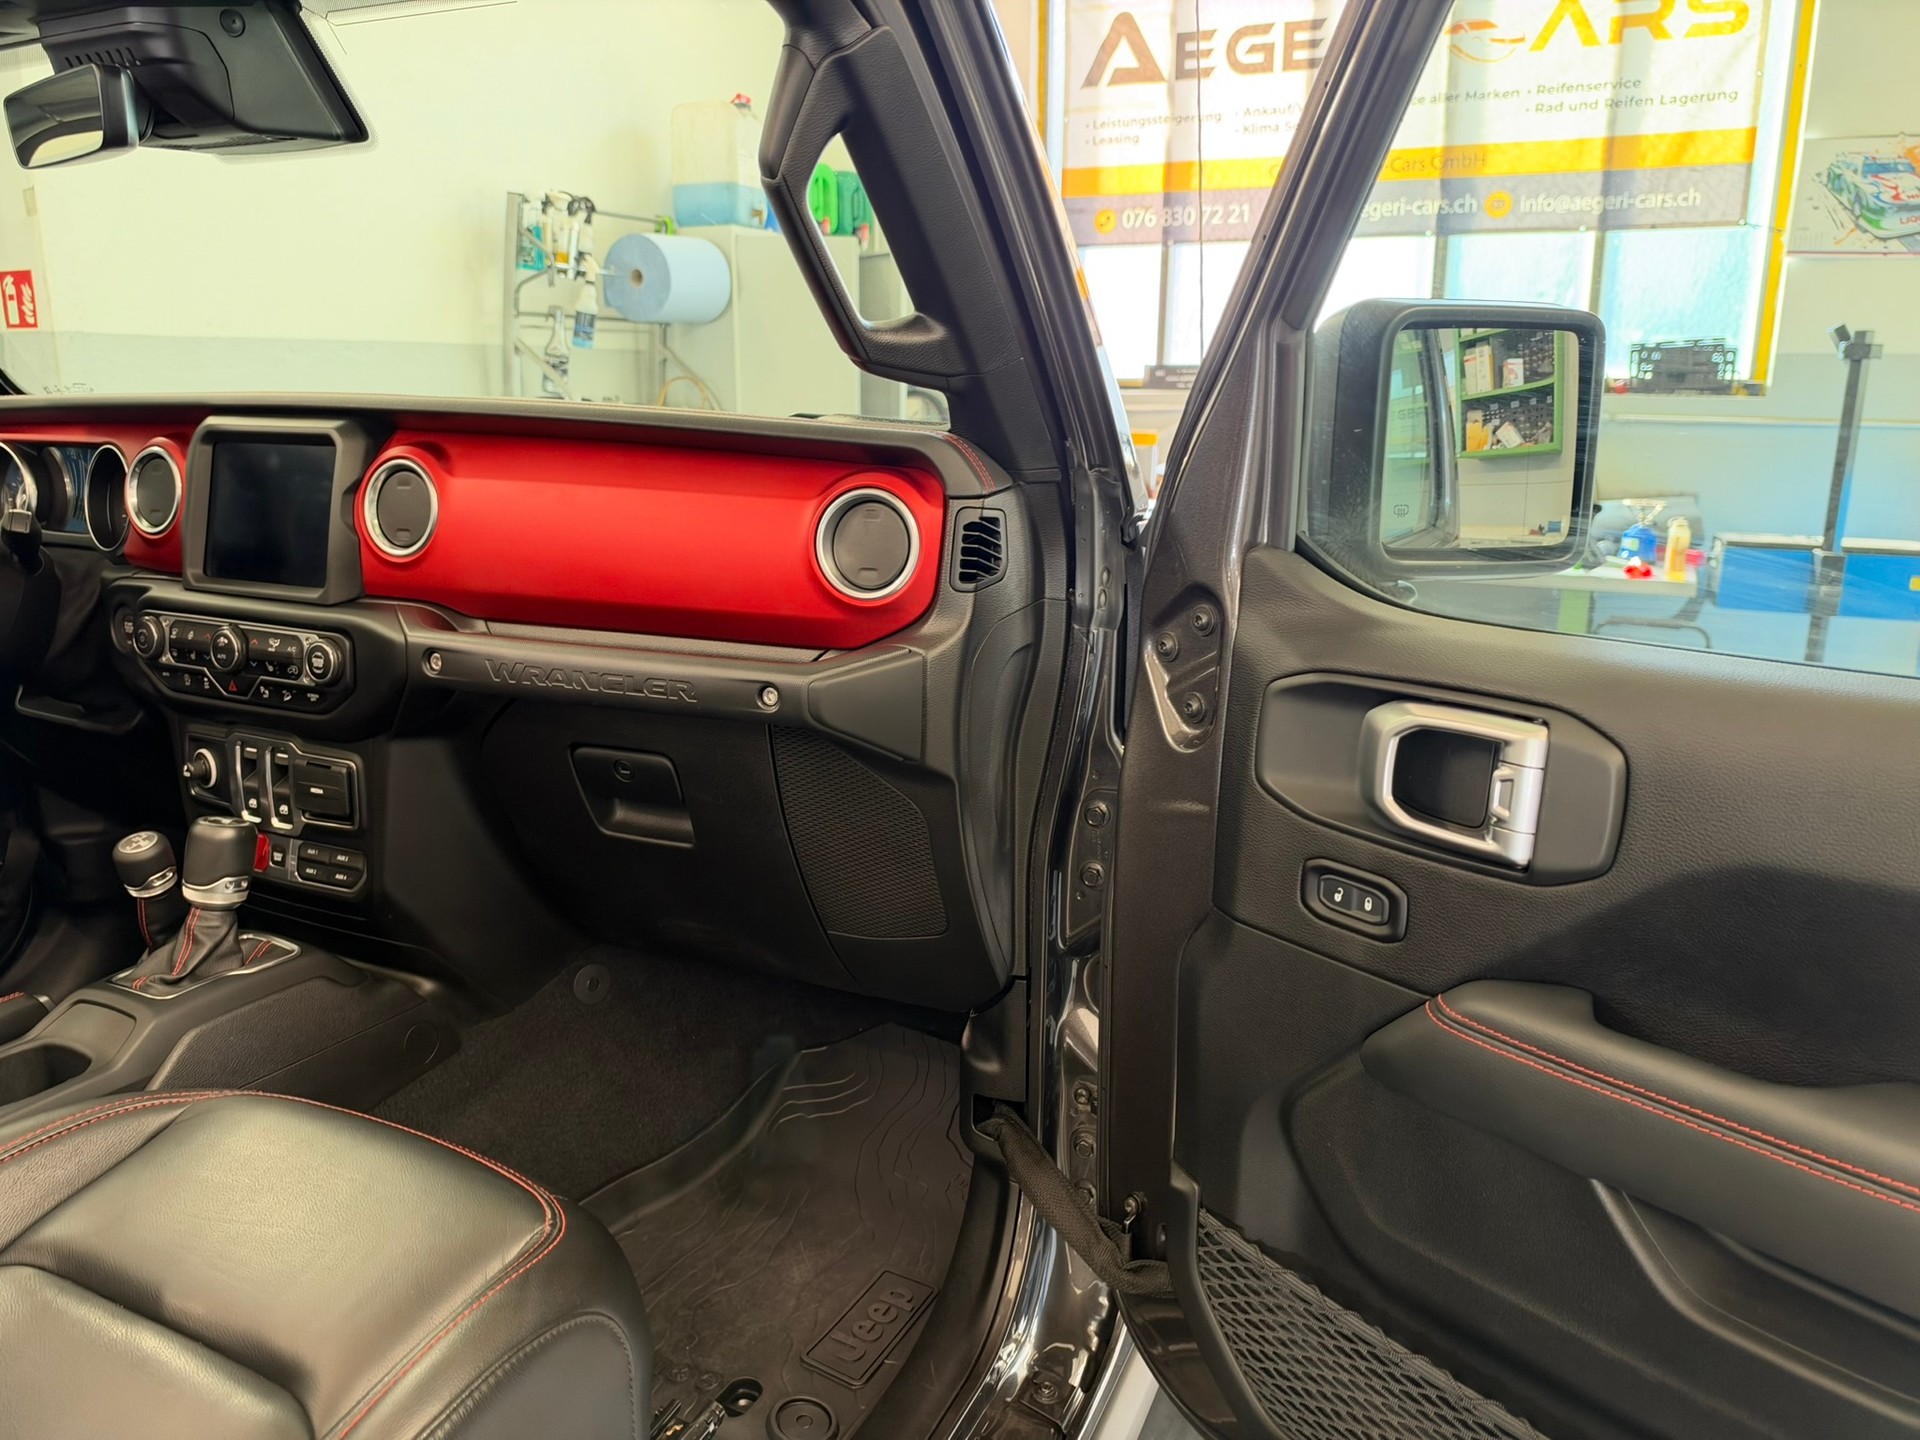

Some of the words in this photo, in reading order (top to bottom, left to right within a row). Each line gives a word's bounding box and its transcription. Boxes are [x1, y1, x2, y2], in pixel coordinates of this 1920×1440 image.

[1081, 12, 1327, 89] AEGE
[1465, 89, 1521, 101] Marken
[1536, 76, 1642, 96] Reifenservice
[1535, 101, 1563, 113] Rad
[1569, 99, 1598, 112] und
[1604, 96, 1654, 109] Reifen
[1660, 89, 1739, 106] Lagerung
[1092, 112, 1222, 130] Leistungssteigerung
[1243, 122, 1280, 135] Klima
[1092, 133, 1140, 147] Leasing
[1430, 152, 1486, 170] GmbH
[1520, 187, 1701, 214] info@aegeri-cars.ch
[1122, 206, 1158, 229] 076
[1163, 205, 1196, 227] 830
[1201, 204, 1223, 225] 72
[1227, 202, 1250, 223] 21
[485, 658, 697, 702] WRANGLER
[829, 1287, 915, 1363] Jeep
